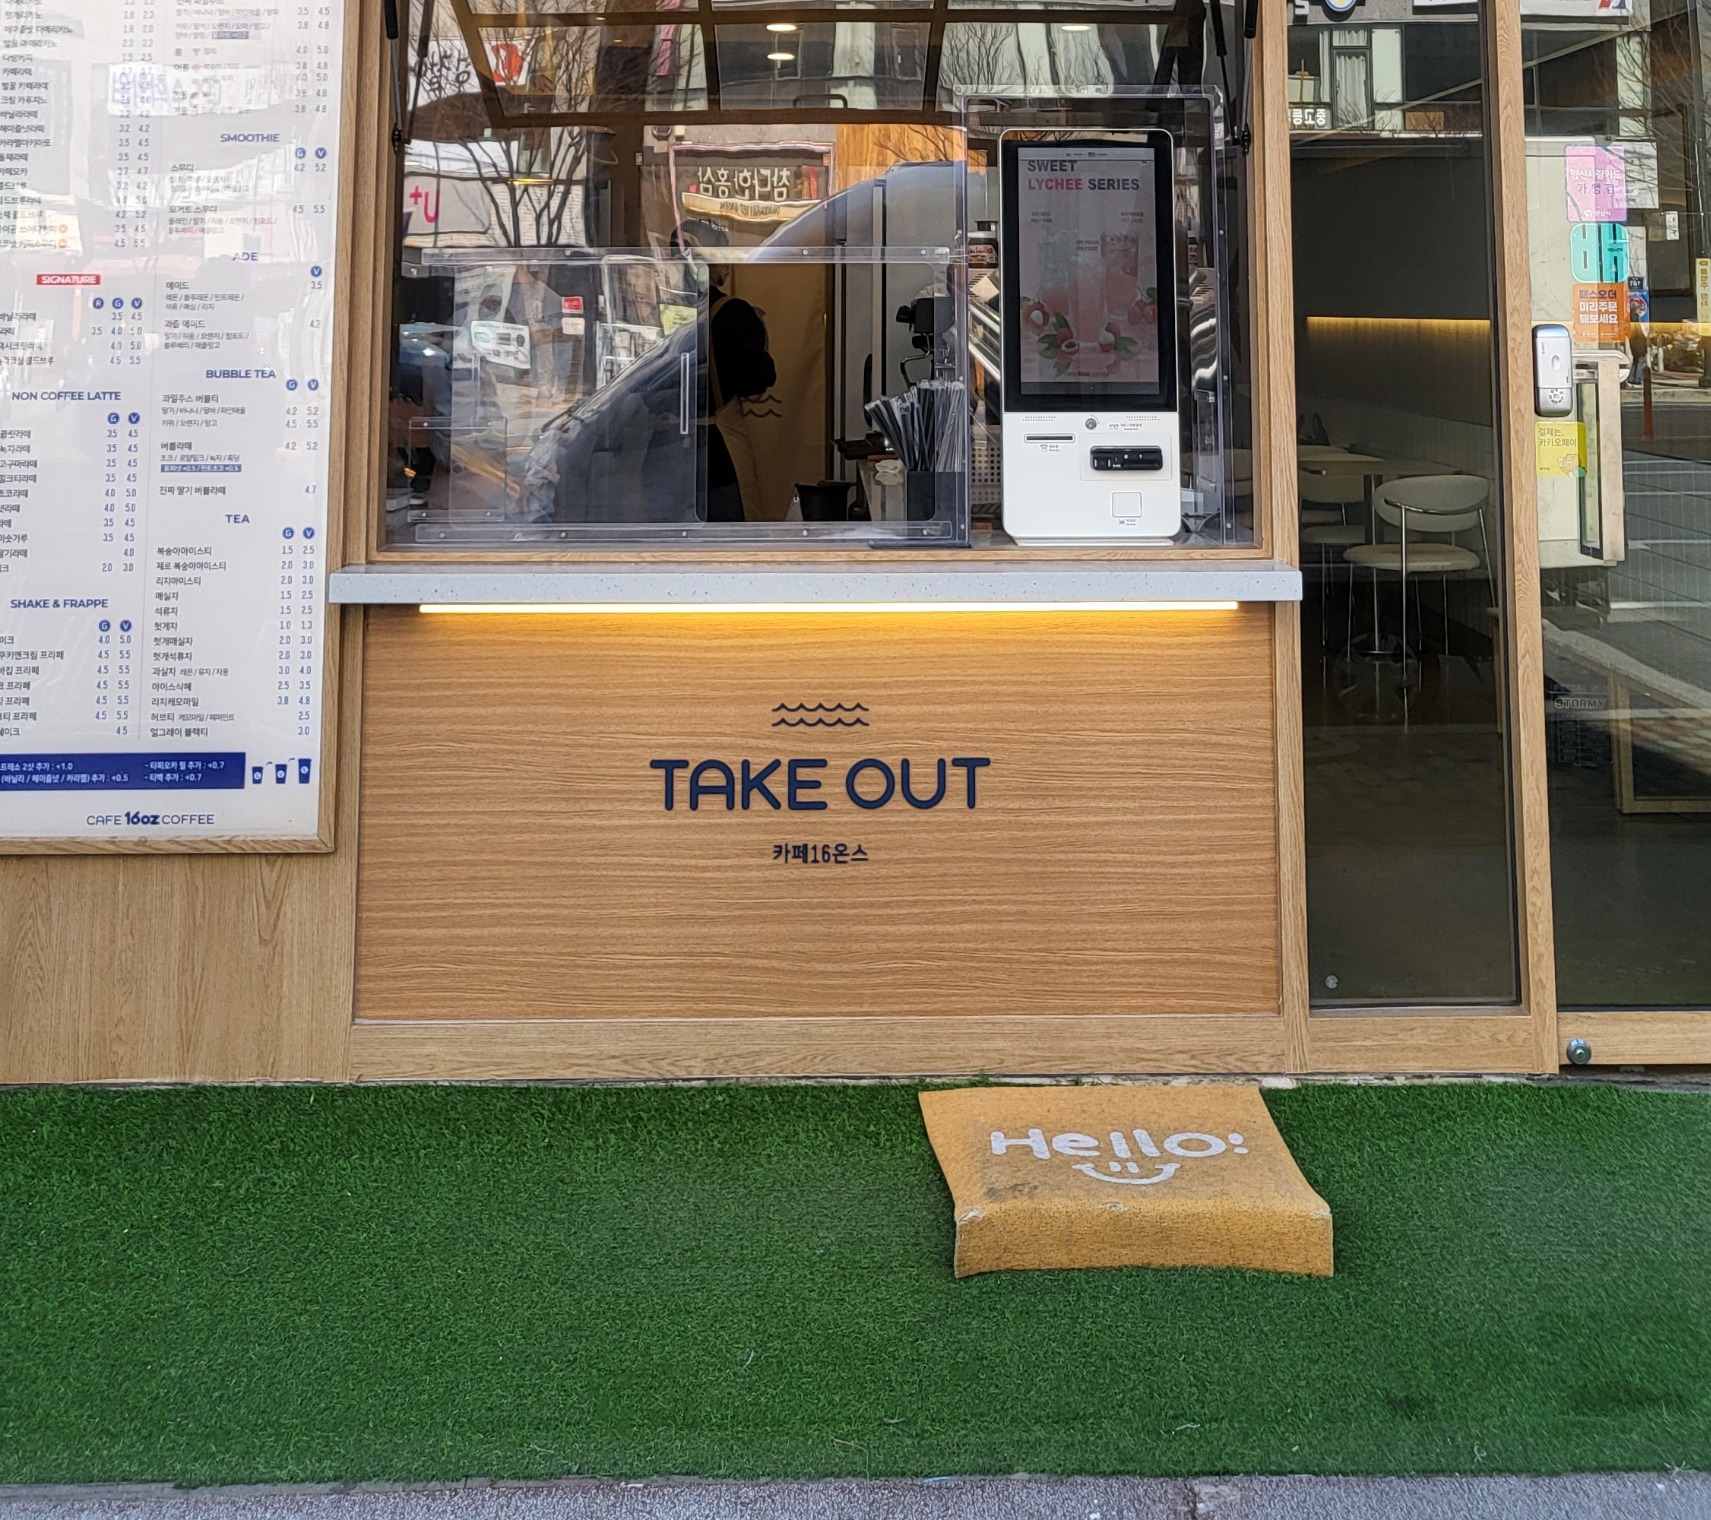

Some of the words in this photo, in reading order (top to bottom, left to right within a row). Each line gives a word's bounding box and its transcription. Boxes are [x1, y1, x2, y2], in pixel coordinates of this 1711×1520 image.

[220, 134, 280, 142] SMOOTHIE
[170, 164, 194, 172] 스무디
[1027, 160, 1078, 172] SWEET
[1027, 178, 1084, 191] LYCHEE
[1087, 178, 1140, 191] SERIES
[168, 206, 192, 214] 요거트
[194, 206, 218, 214] 스무디
[40, 274, 97, 284] SIGNATURE
[166, 281, 190, 290] 에이드
[1579, 301, 1619, 313] 미리주문
[1579, 313, 1619, 325] 해보세요
[206, 370, 252, 379] BUBBLE
[254, 370, 276, 379] TEA
[12, 391, 38, 401] NON
[40, 391, 85, 401] COFFEE
[87, 391, 122, 401] LATTE
[176, 486, 192, 495] 딸기
[225, 514, 250, 524] TEA
[124, 548, 134, 557] 4.0
[156, 546, 212, 556] 복숭아아이스티
[102, 563, 113, 572] 2.0
[282, 561, 293, 570] 2.0
[280, 590, 292, 600] 1.5
[302, 590, 313, 600] 2.5
[10, 598, 51, 608] SHAKE
[52, 598, 60, 608] &
[63, 598, 109, 608] FRAPPE
[280, 606, 292, 614] 1.5
[301, 606, 312, 614] 2.5
[98, 635, 110, 644] 4.0
[120, 635, 132, 644] 5.0
[279, 636, 290, 644] 2.0
[98, 650, 110, 659] 4.5
[120, 650, 131, 659] 5.5
[278, 650, 290, 660] 2.0
[300, 650, 312, 660] 3.0
[97, 665, 108, 674] 4.5
[118, 665, 130, 674] 5.5
[278, 666, 290, 674] 3.0
[300, 666, 312, 674] 4.0
[96, 680, 108, 690] 4.5
[118, 680, 130, 690] 5.5
[278, 681, 290, 690] 2.5
[299, 681, 310, 690] 3.5
[96, 696, 108, 705] 4.5
[118, 696, 129, 705] 5.5
[298, 696, 310, 705] 4.8
[95, 711, 106, 720] 4.5
[116, 711, 128, 720] 5.5
[150, 712, 175, 722] 허브티
[298, 712, 310, 720] 2.5
[116, 726, 128, 735] 4.5
[298, 726, 310, 736] 3.0
[35, 762, 50, 771] 추가
[56, 762, 74, 770] +1.0
[150, 760, 178, 770] 타피오카
[187, 760, 202, 770] 추가
[208, 761, 224, 770] +0.7
[90, 774, 106, 783] 추가
[110, 774, 129, 782] +0.5
[185, 773, 202, 782] +0.7
[649, 758, 828, 812] TAKE
[845, 757, 991, 810] OUT
[86, 815, 122, 826] CAFE
[124, 811, 160, 826] 16oz
[162, 814, 215, 825] COFFEE
[771, 842, 869, 865] 카페16온스
